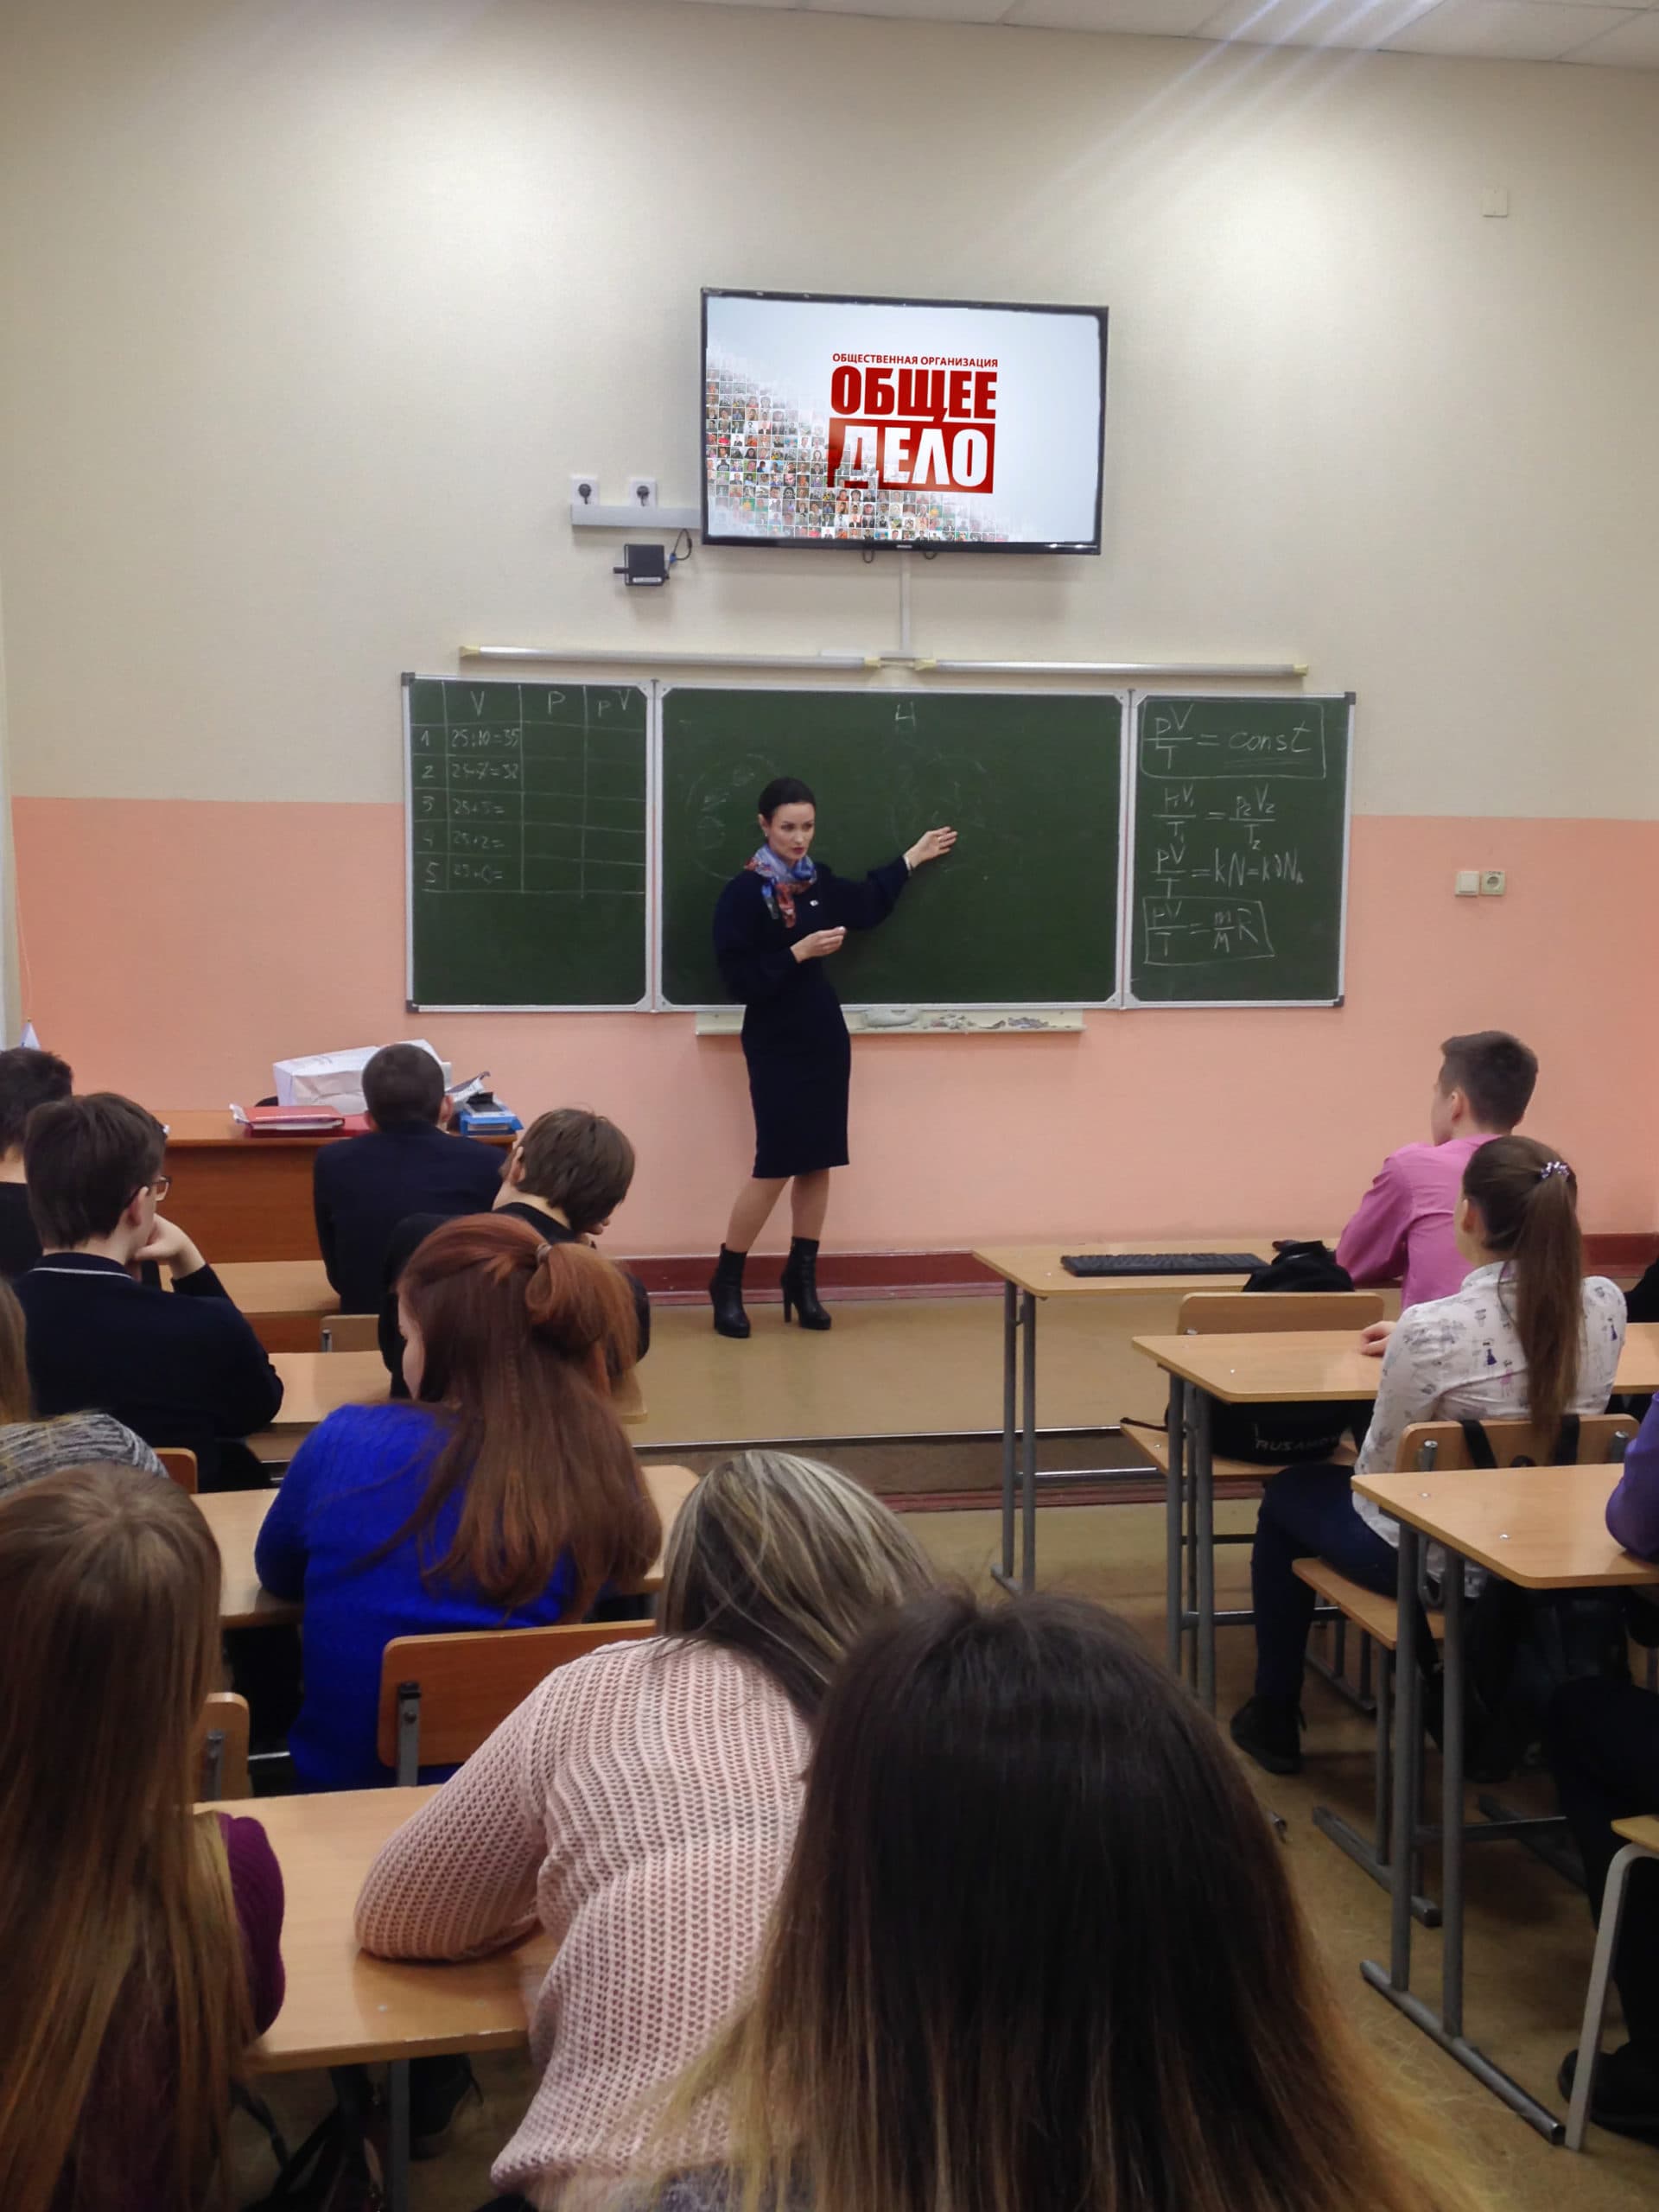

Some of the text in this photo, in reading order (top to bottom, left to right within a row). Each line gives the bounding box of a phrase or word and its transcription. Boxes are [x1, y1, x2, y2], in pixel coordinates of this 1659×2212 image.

[832, 353, 998, 368] ОБЩЕСТВЕННАЯ ОРГАНИЗАЦИЯ
[830, 365, 998, 423] ОБЩЕЕ
[834, 425, 988, 489] ДЕЛО
[470, 690, 486, 717] V
